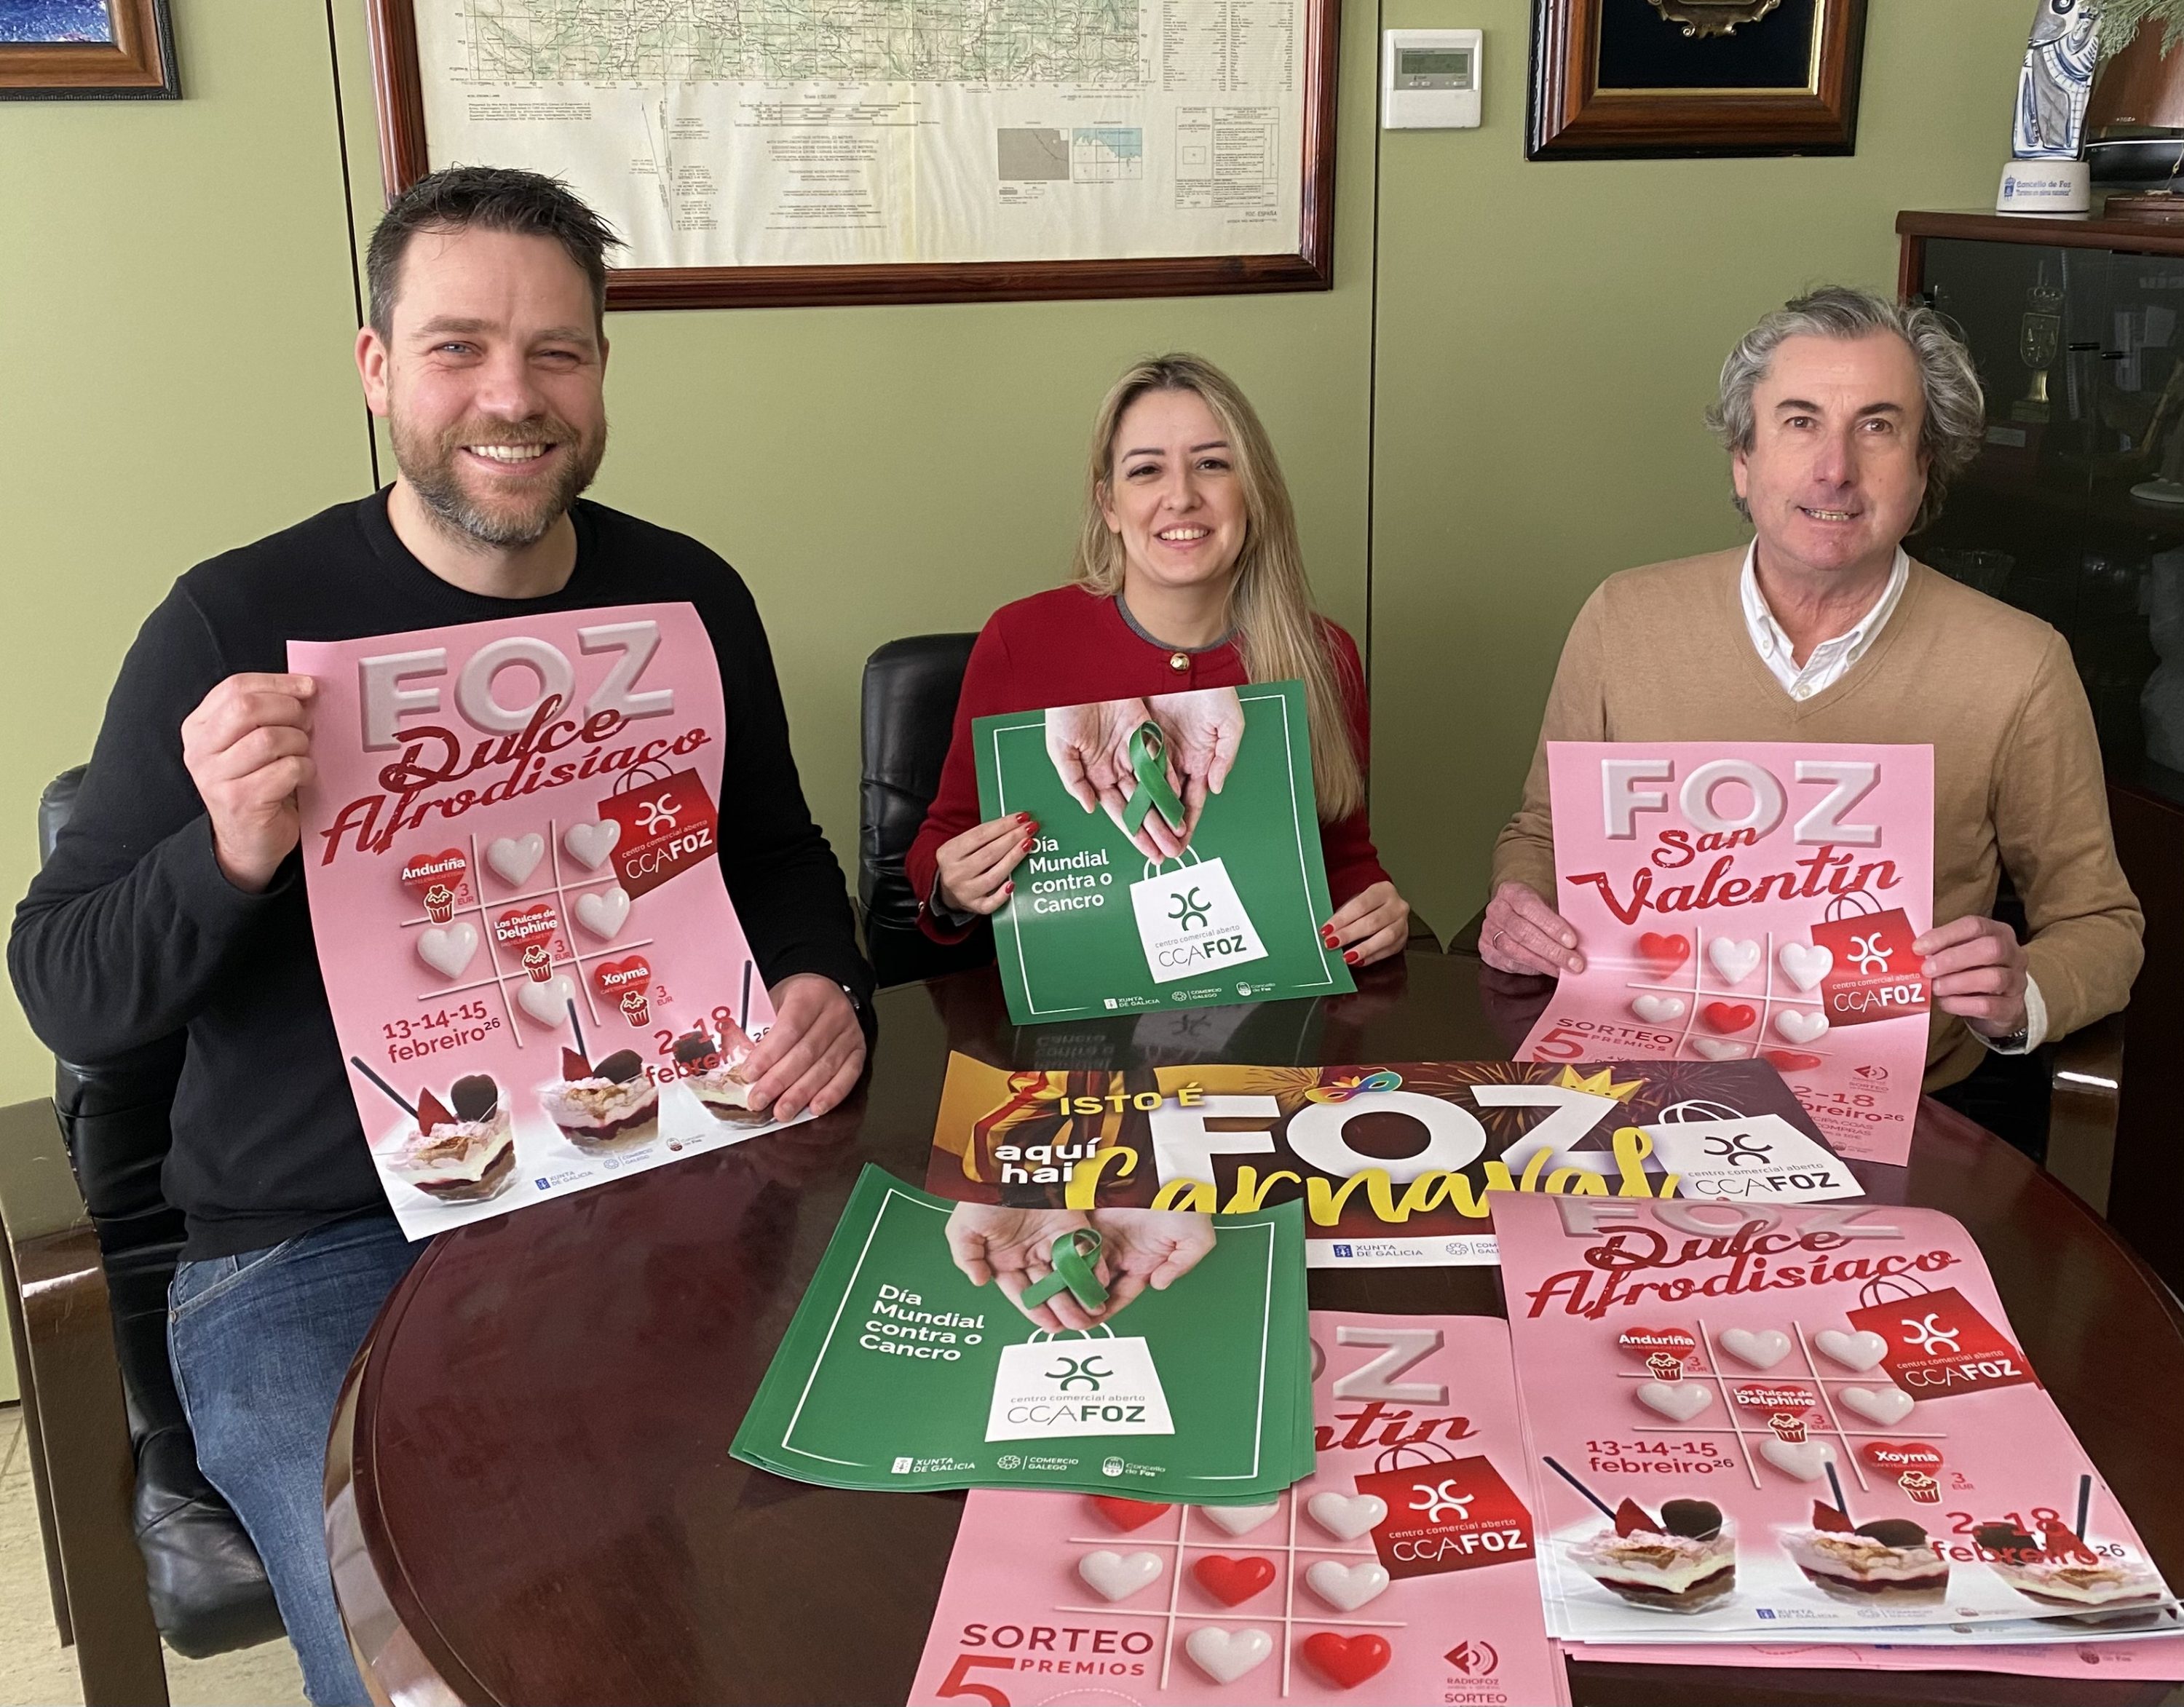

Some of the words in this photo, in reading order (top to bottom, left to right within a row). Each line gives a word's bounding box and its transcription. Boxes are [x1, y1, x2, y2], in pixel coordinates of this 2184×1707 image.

[358, 619, 675, 753] FOZ
[379, 694, 631, 794] Dulce
[320, 728, 711, 866] Afrodisíaco
[1602, 759, 1883, 848] FOZ
[622, 844, 646, 858] centro
[646, 828, 682, 847] comercial
[683, 820, 708, 833] aberto
[1029, 836, 1059, 854] Día
[1652, 827, 1761, 868] San
[626, 828, 713, 879] CCAFOZ
[1029, 849, 1109, 874] Mundial
[402, 858, 466, 880] Anduriña
[460, 883, 469, 896] 3
[1031, 874, 1096, 894] contra
[1100, 873, 1112, 885] o
[1565, 845, 1904, 926] Valentín
[457, 896, 475, 905] EUR
[1034, 894, 1104, 914] Cancro
[494, 920, 510, 929] Los
[511, 913, 542, 925] Dulces
[543, 909, 555, 917] de
[496, 919, 558, 940] Delphine
[555, 940, 565, 952] 3
[1155, 939, 1179, 948] centro
[1179, 930, 1215, 943] comercial
[1216, 924, 1240, 935] aberto
[555, 952, 571, 961] EUR
[1159, 935, 1247, 967] CCAFOZ
[601, 967, 649, 986] Xoyma
[1832, 981, 1856, 990] centro
[1858, 975, 1894, 987] comercial
[1896, 973, 1920, 982] aberto
[656, 986, 666, 997] 3
[657, 996, 673, 1006] EUR
[1834, 983, 1926, 1013] CCAFOZ
[382, 1001, 488, 1040] 13-14-15
[1556, 1018, 1673, 1044] SORTEO
[1535, 1028, 1589, 1058] 5
[1591, 1034, 1666, 1051] PREMIOS
[1848, 1082, 1889, 1091] SORTEO
[1059, 1093, 1163, 1117] ISTO
[1178, 1082, 1206, 1107] É
[1148, 1085, 1663, 1192] FOZ
[994, 1137, 1101, 1165] aquí
[550, 1171, 575, 1182] XUNTA
[563, 1171, 593, 1183] GALICIA
[1001, 1162, 1072, 1184] hai
[1065, 1127, 1680, 1226] Carnaval
[1688, 1169, 1725, 1177] centro
[1727, 1166, 1784, 1176] comercial
[1787, 1163, 1824, 1171] aberto
[1696, 1172, 1840, 1197] CCAFOZ
[1553, 1195, 1905, 1240] FOZ
[1583, 1220, 1856, 1273] Dulce
[1525, 1245, 1961, 1320] Afrodisíaco
[879, 1284, 922, 1306] Día
[872, 1300, 984, 1329] Mundial
[865, 1320, 957, 1344] contra
[964, 1334, 982, 1345] o
[1618, 1333, 1696, 1346] Anduriña
[859, 1334, 961, 1361] Cancro
[1688, 1356, 1701, 1367] 3
[1896, 1361, 1927, 1369] centro
[1928, 1355, 1973, 1366] comercial
[1974, 1350, 2004, 1360] aberto
[1904, 1359, 2022, 1387] CCAFOZ
[1010, 1395, 1046, 1403] centro
[1049, 1394, 1105, 1402] comercial
[1733, 1388, 1754, 1396] Los
[1756, 1389, 1796, 1397] Dulces
[1736, 1394, 1816, 1407] Delphine
[1008, 1405, 1146, 1426] CCAFOZ
[1811, 1414, 1825, 1424] 3
[1586, 1439, 1719, 1457] 13-14-15
[1875, 1449, 1939, 1468] Xoyma
[913, 1465, 929, 1473] DE
[931, 1462, 976, 1472] GALICIA
[916, 1457, 954, 1466] XUNTA
[1028, 1463, 1068, 1471] GALEGO
[1030, 1457, 1079, 1465] COMERCIO
[1125, 1462, 1166, 1473] Concello
[1952, 1471, 1967, 1484] 3
[1952, 1483, 1975, 1491] EUR
[1388, 1530, 1424, 1539] centro
[1426, 1521, 1479, 1535] comercial
[1481, 1518, 1516, 1529] aberto
[1393, 1529, 1528, 1561] CCAFOZ
[960, 1624, 1154, 1655] SORTEO
[935, 1654, 1016, 1707] 5
[1020, 1659, 1145, 1676] PREMIOS
[1447, 1677, 1500, 1686] RADIOFOZ
[1444, 1693, 1508, 1703] SORTEO
